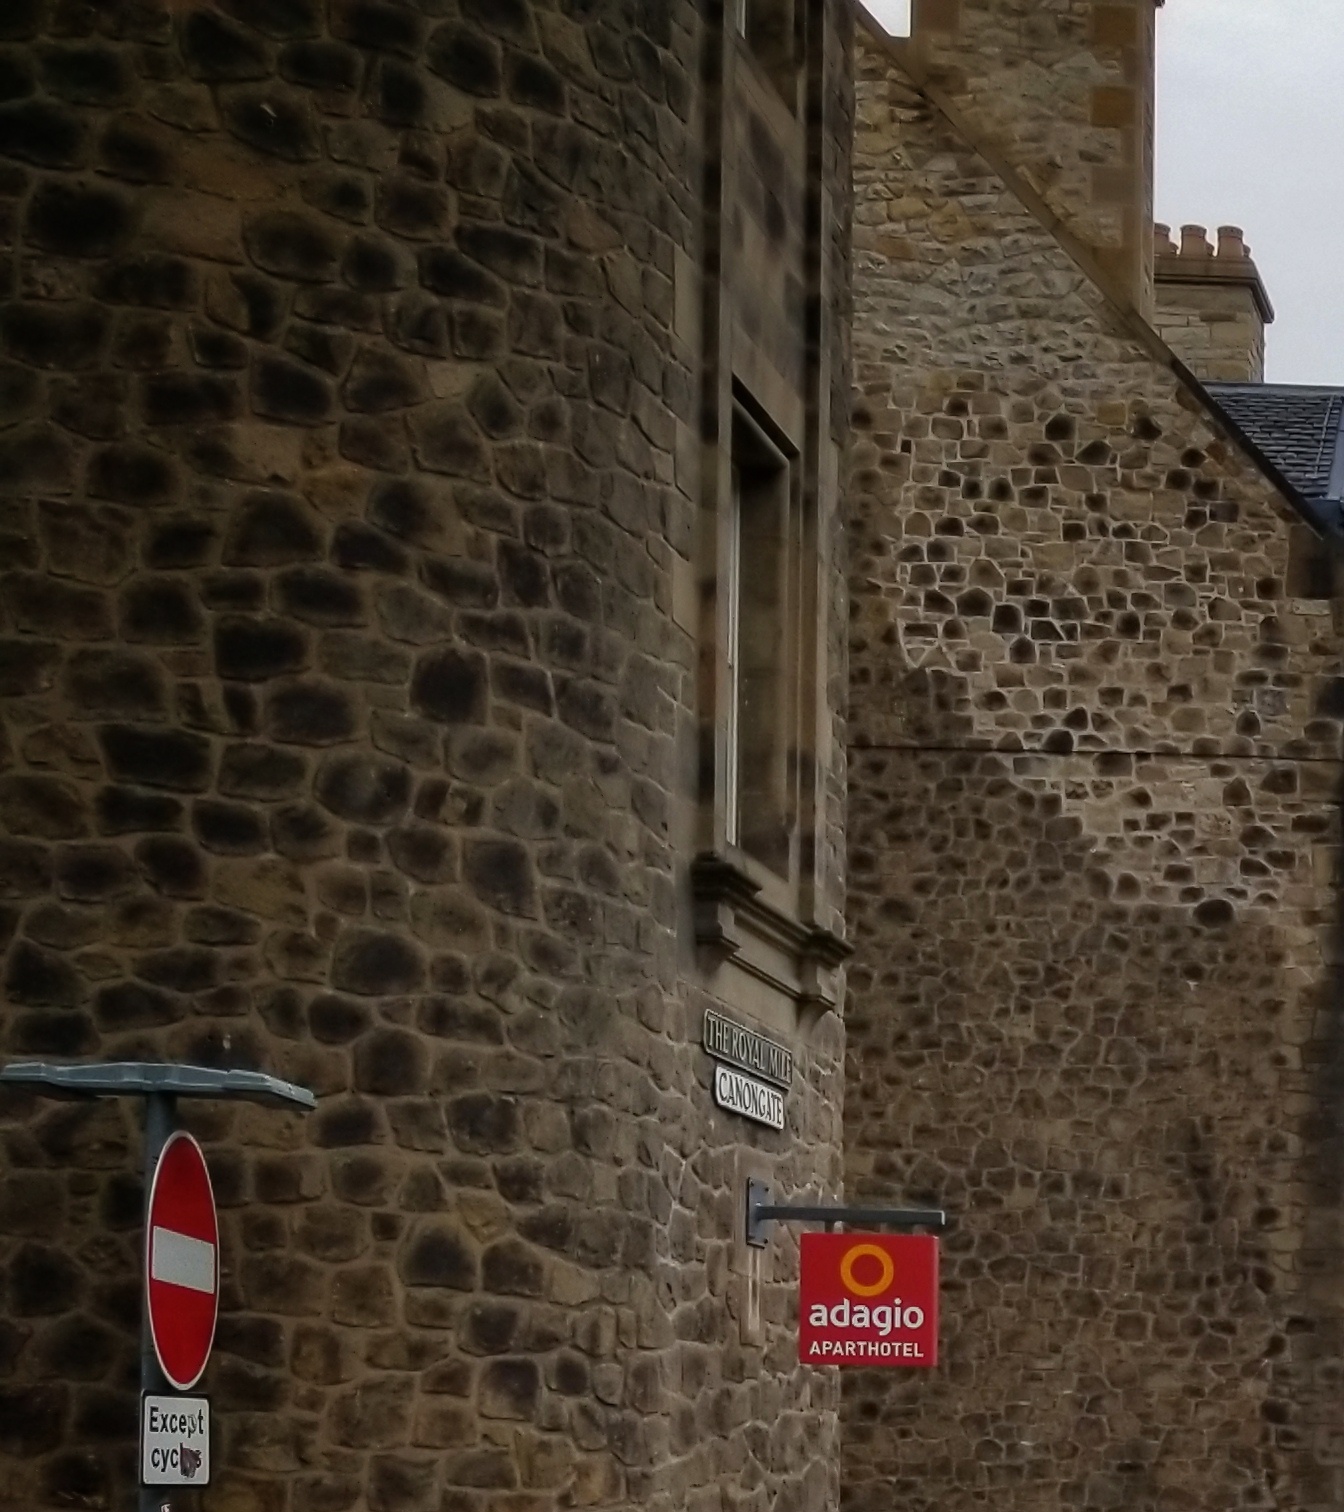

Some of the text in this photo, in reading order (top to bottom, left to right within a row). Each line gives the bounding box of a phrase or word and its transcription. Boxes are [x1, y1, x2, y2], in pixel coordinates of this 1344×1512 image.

[707, 1014, 792, 1084] THE ROYAL MILE
[719, 1072, 783, 1125] CANONGATE
[808, 1297, 925, 1336] adagio
[809, 1340, 925, 1358] APARTHOTEL
[148, 1405, 204, 1438] Except
